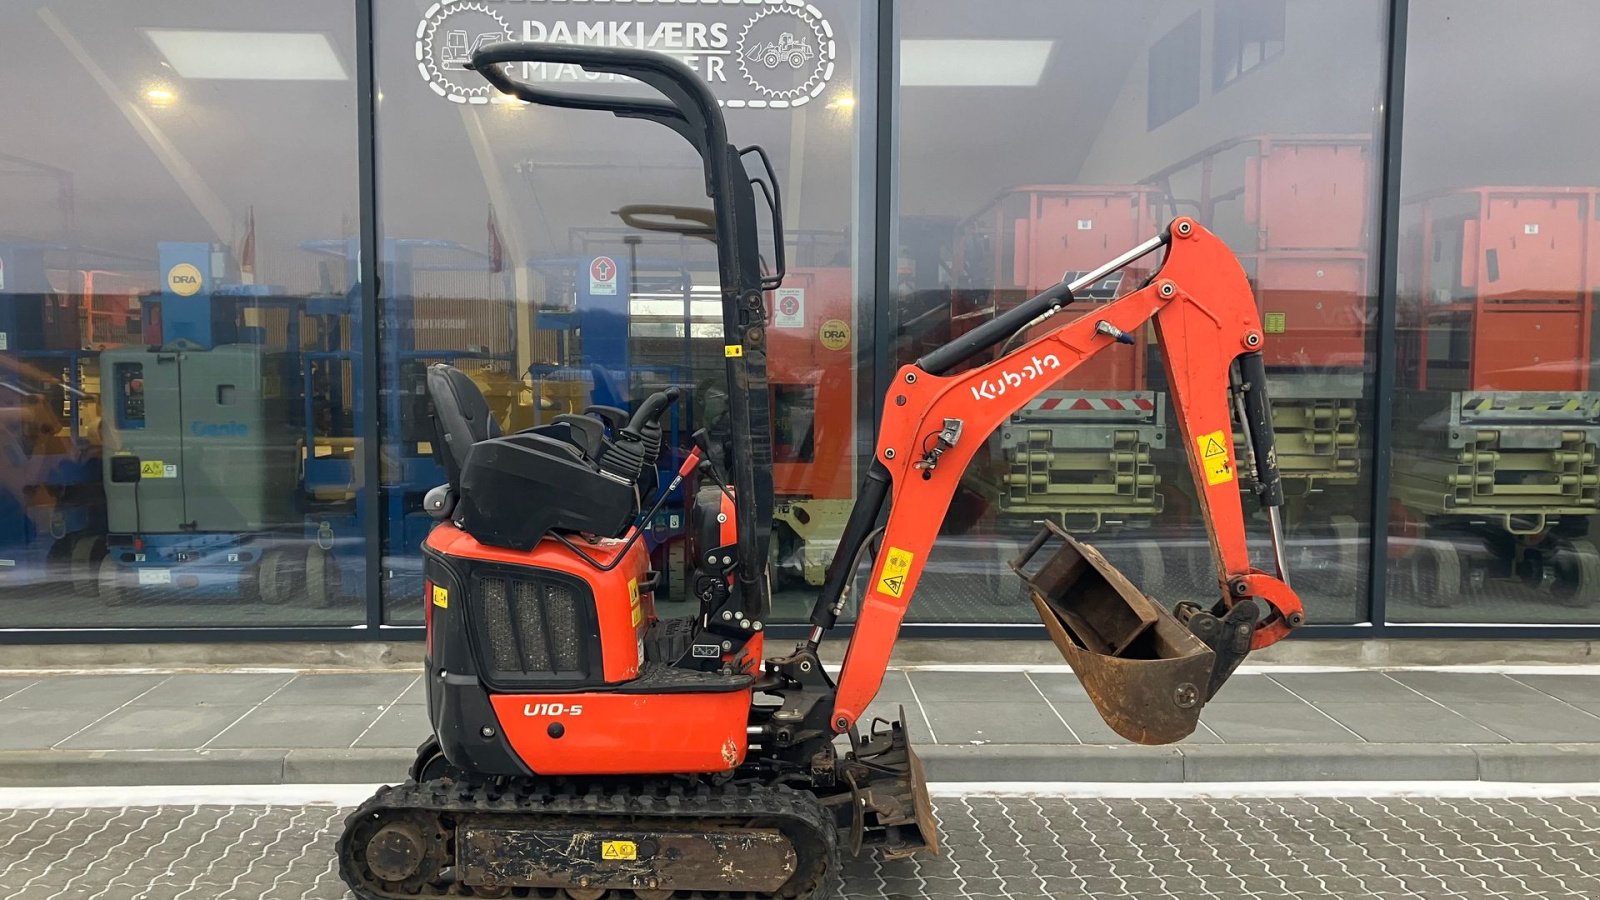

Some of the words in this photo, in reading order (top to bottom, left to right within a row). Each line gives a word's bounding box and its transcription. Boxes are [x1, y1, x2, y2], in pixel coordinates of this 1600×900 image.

[522, 20, 728, 49] DAMKJÆRS
[173, 275, 196, 284] DRA
[824, 330, 846, 339] DRA
[970, 354, 1061, 401] Kubota
[523, 703, 583, 716] U10-5
